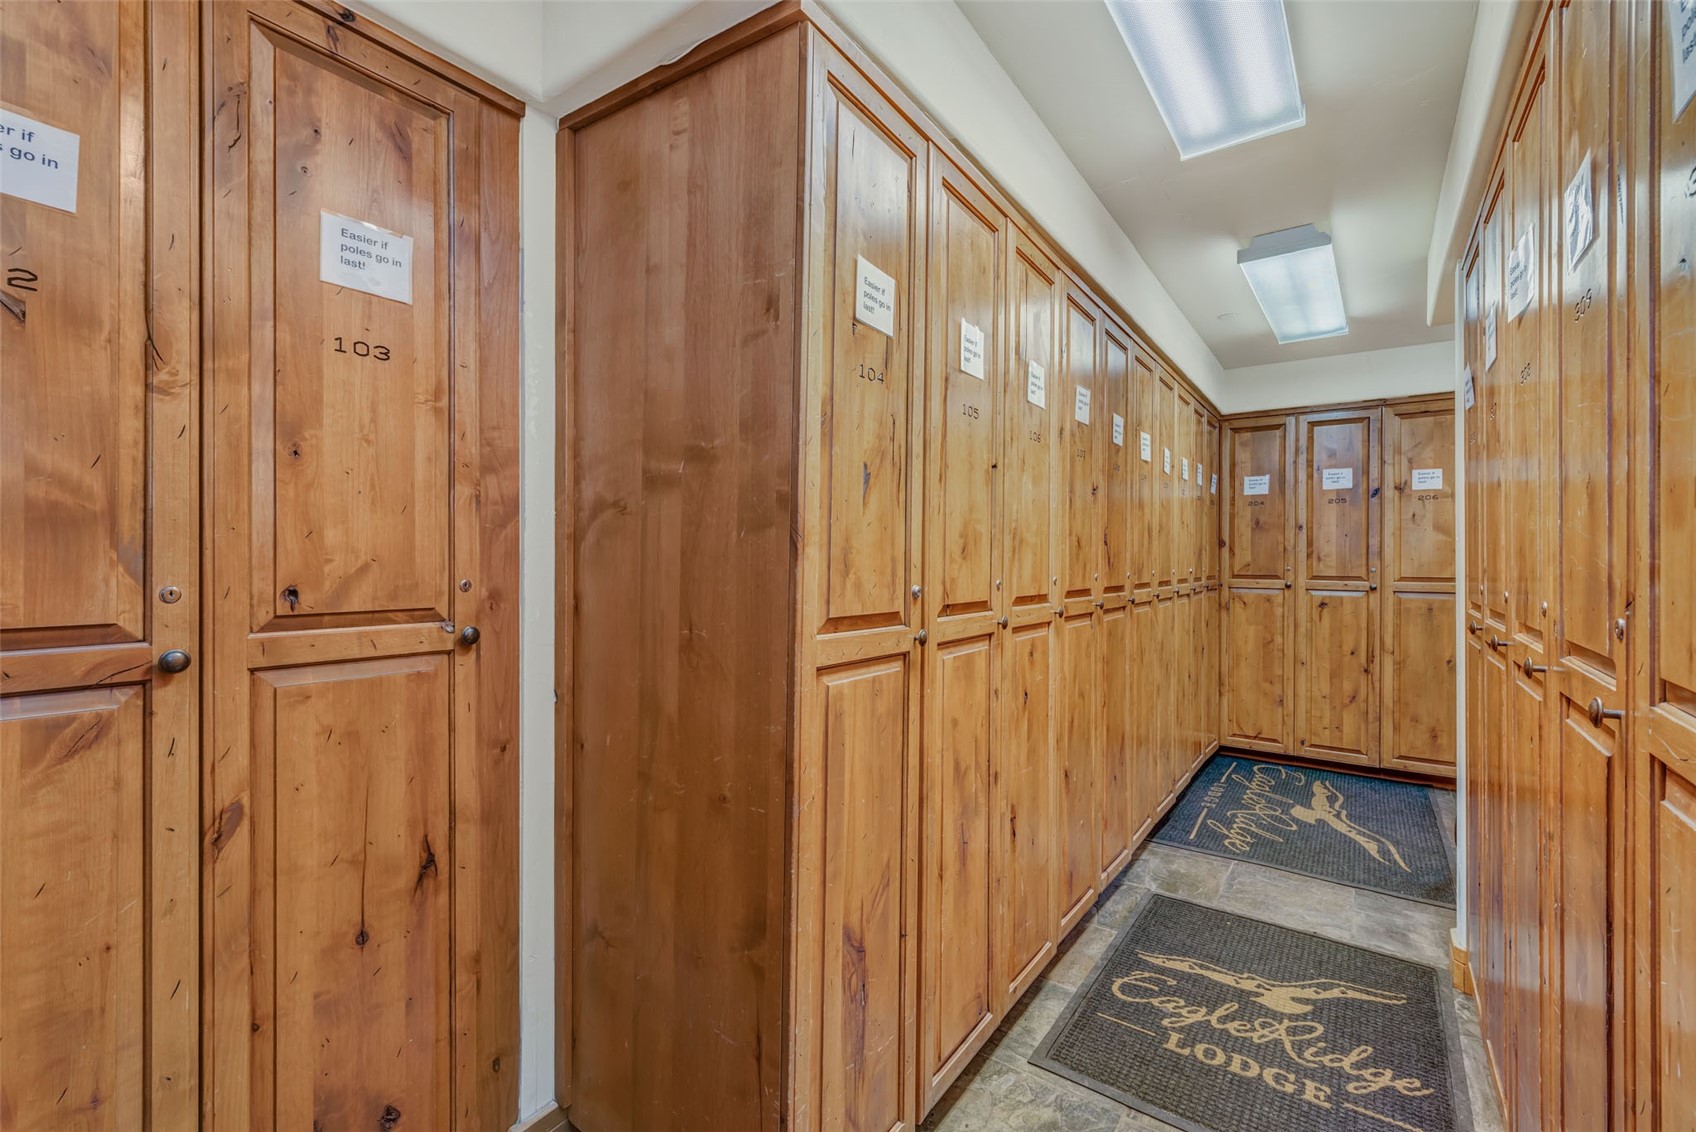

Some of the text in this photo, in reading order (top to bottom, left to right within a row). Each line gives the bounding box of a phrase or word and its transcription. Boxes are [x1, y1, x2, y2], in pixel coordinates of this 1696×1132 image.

[22, 129, 35, 142] if
[10, 147, 35, 161] go
[42, 154, 58, 169] in
[341, 228, 388, 250] Easier if
[340, 243, 402, 268] poles go in
[340, 255, 365, 270] last!
[864, 290, 877, 304] poles
[879, 299, 886, 309] go
[334, 337, 390, 361] 103
[859, 364, 884, 384] 104
[963, 404, 979, 420] 105
[1162, 1031, 1332, 1109] LODGE
